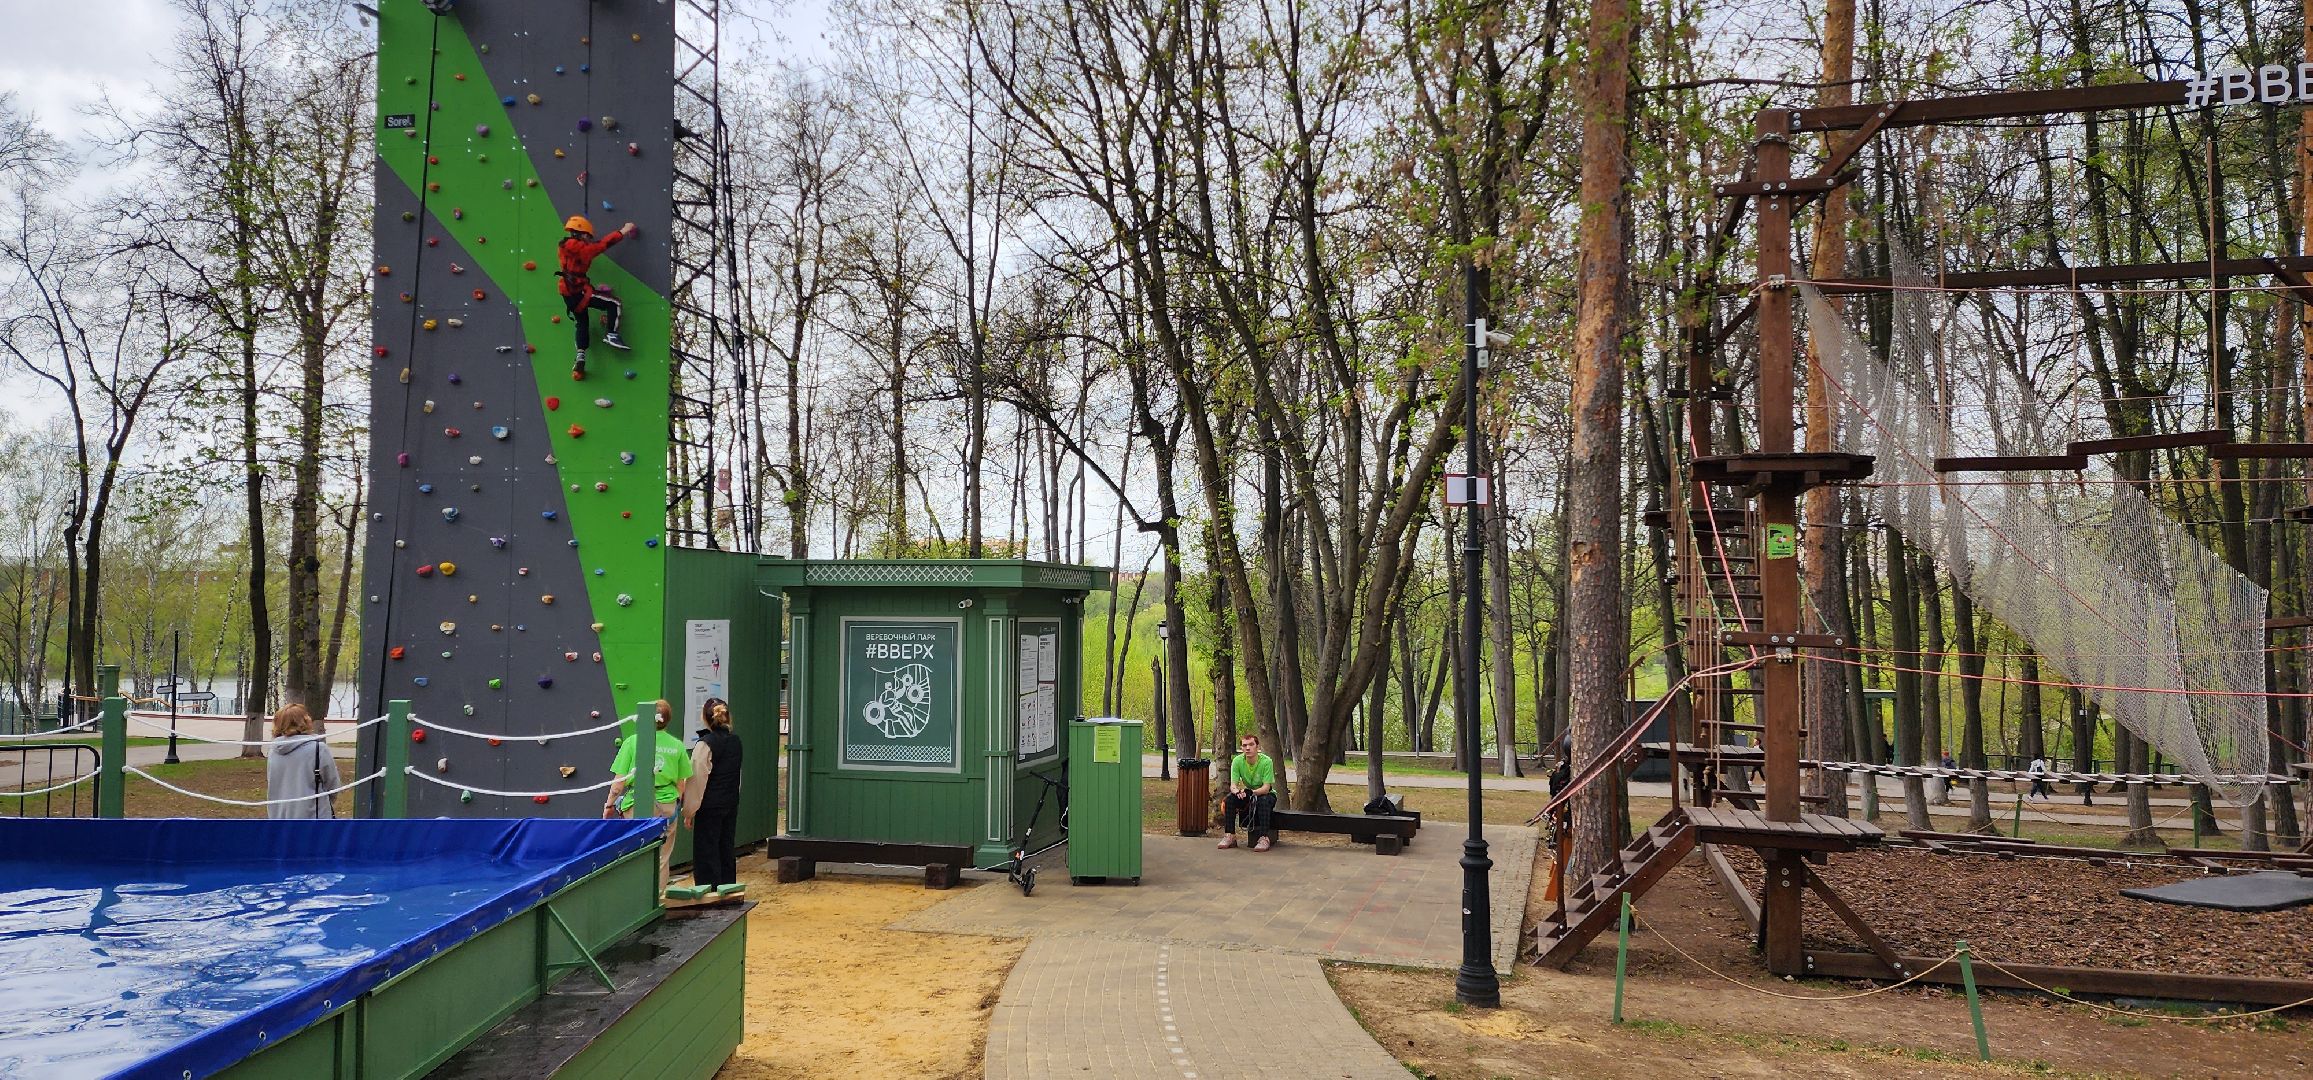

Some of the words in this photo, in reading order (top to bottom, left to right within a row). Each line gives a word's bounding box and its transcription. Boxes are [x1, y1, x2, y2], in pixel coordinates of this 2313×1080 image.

[865, 632, 916, 641] ВЕРЕВОЧНЫЙ
[917, 633, 936, 641] ПАРК
[865, 643, 934, 660] #ВВЕРХ
